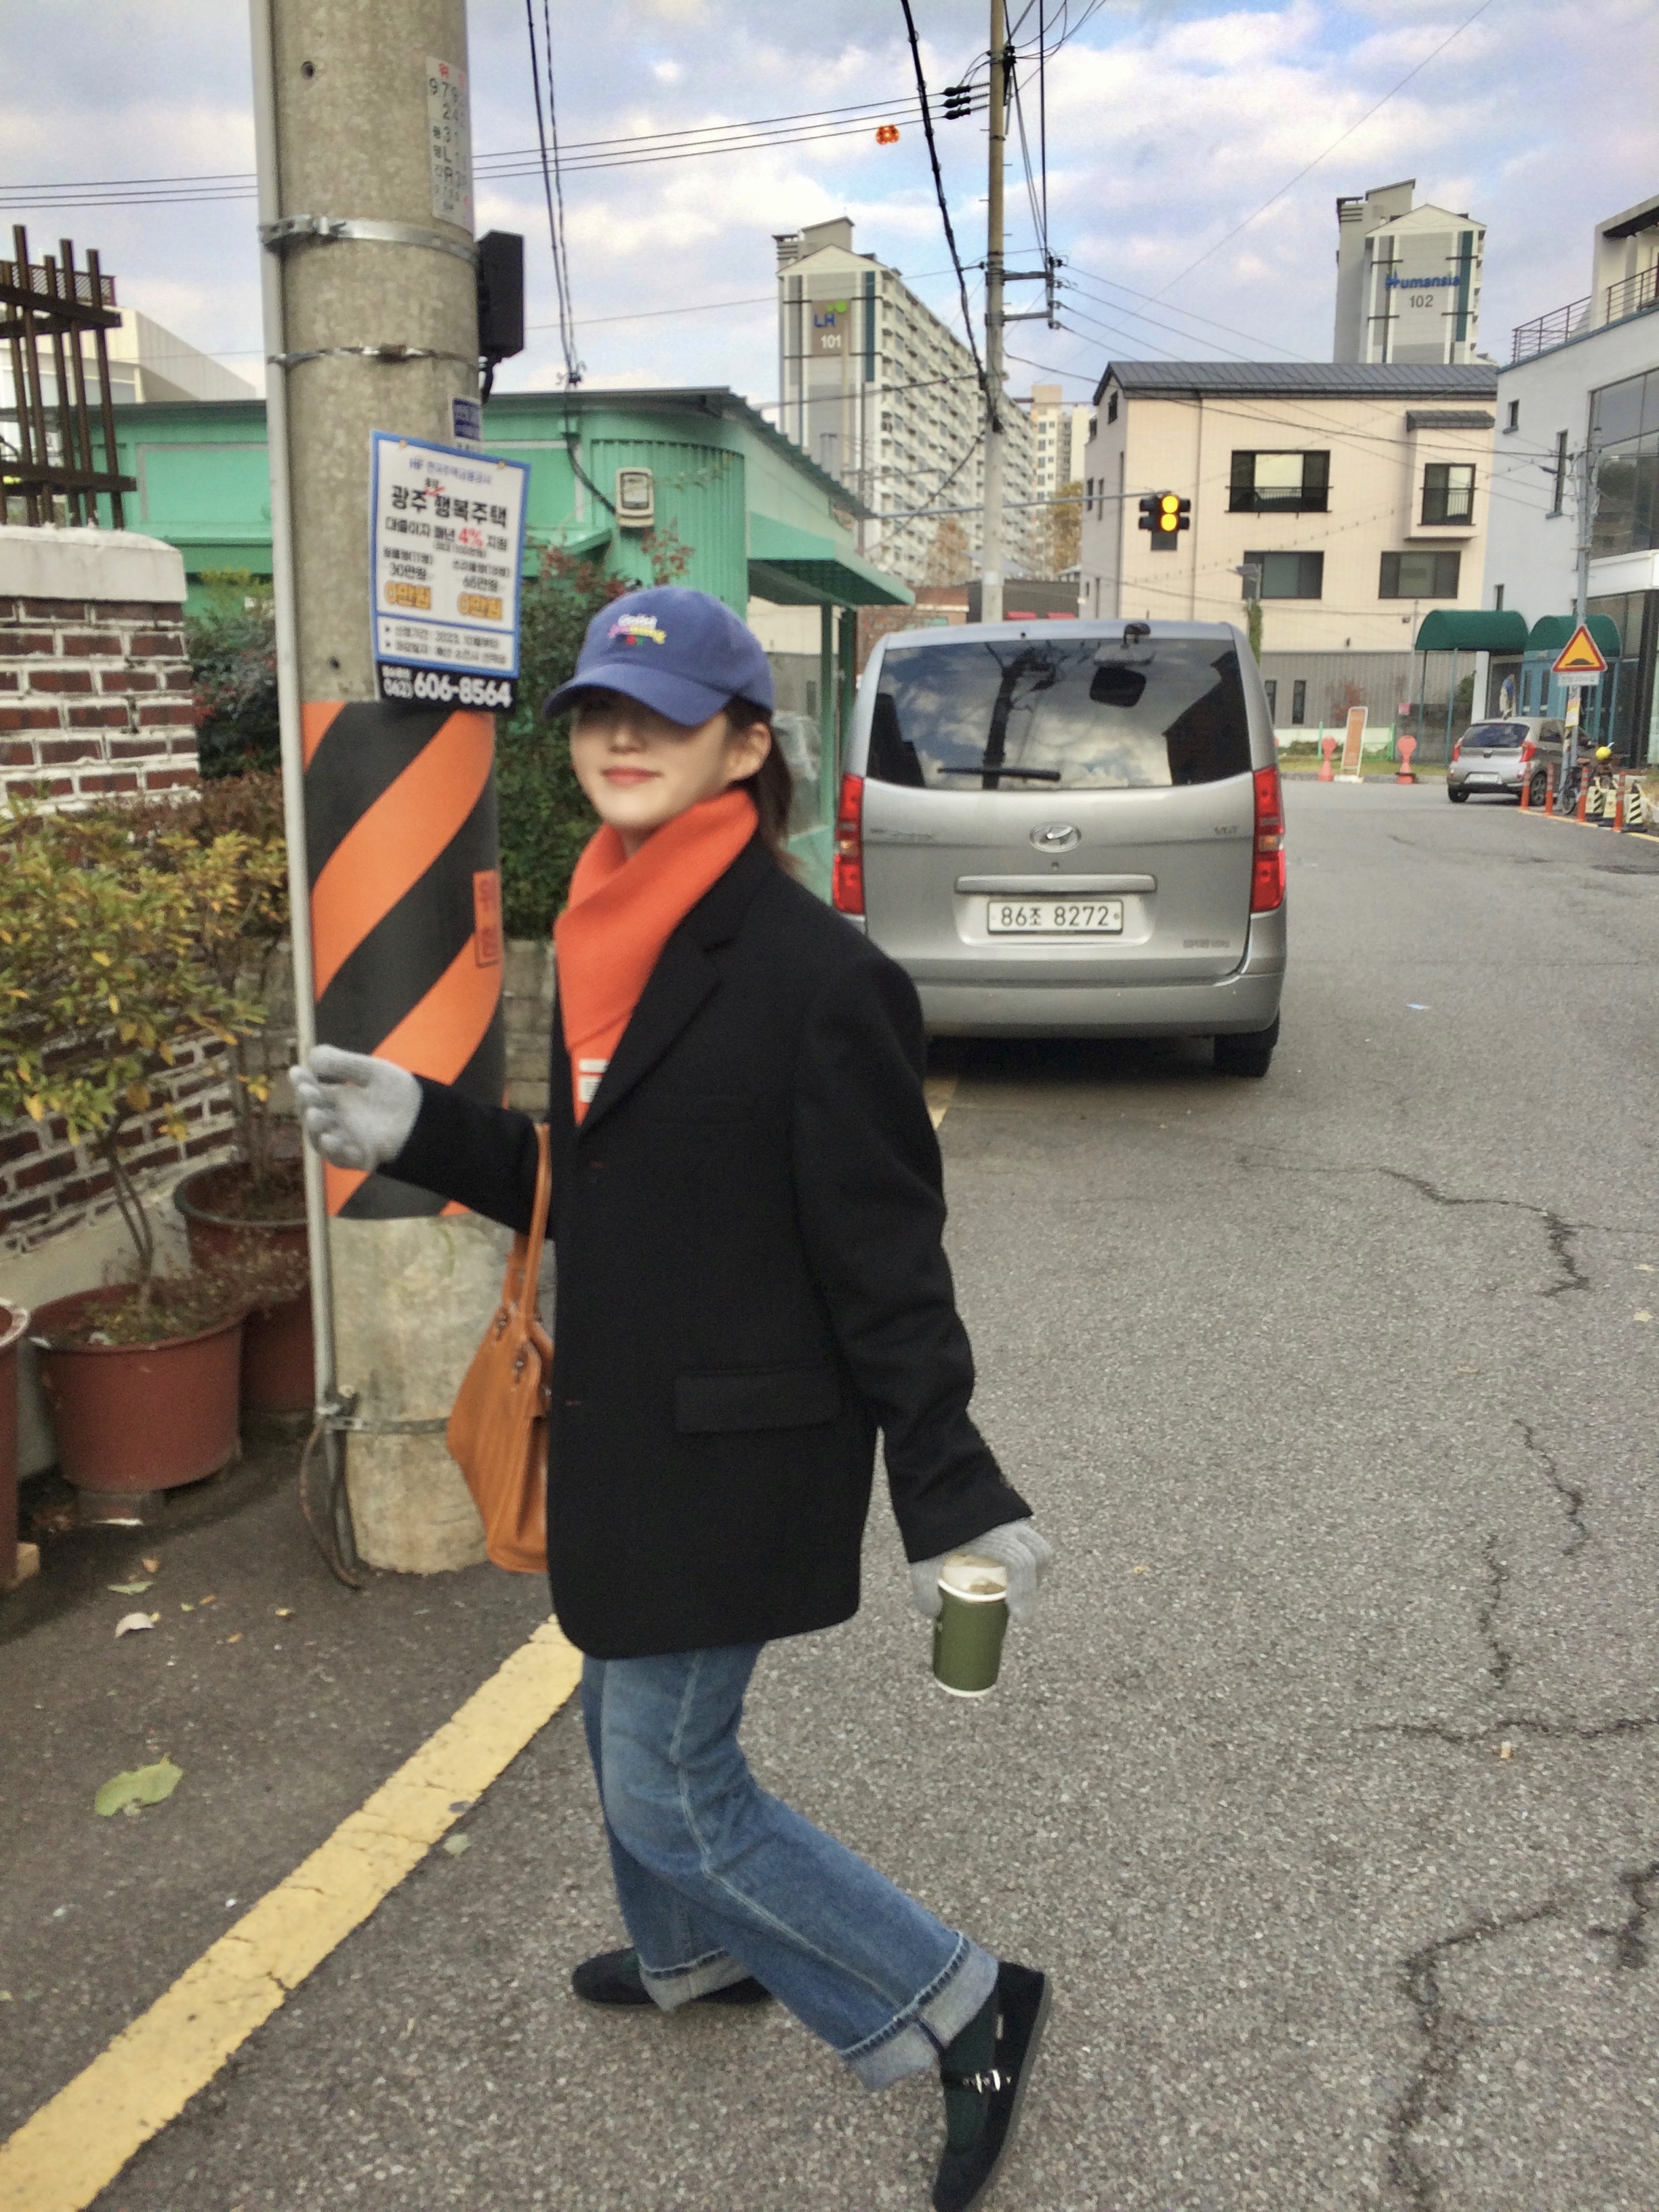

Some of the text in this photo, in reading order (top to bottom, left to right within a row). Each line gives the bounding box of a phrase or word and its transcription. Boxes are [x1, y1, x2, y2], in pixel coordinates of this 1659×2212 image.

[1410, 295, 1434, 308] 102
[814, 314, 835, 328] LH
[821, 333, 842, 349] 101
[392, 484, 508, 528] 광주 행복주택
[459, 527, 483, 548] 4%
[414, 672, 513, 708] 606-8564
[1000, 905, 1109, 926] 86조 8272
